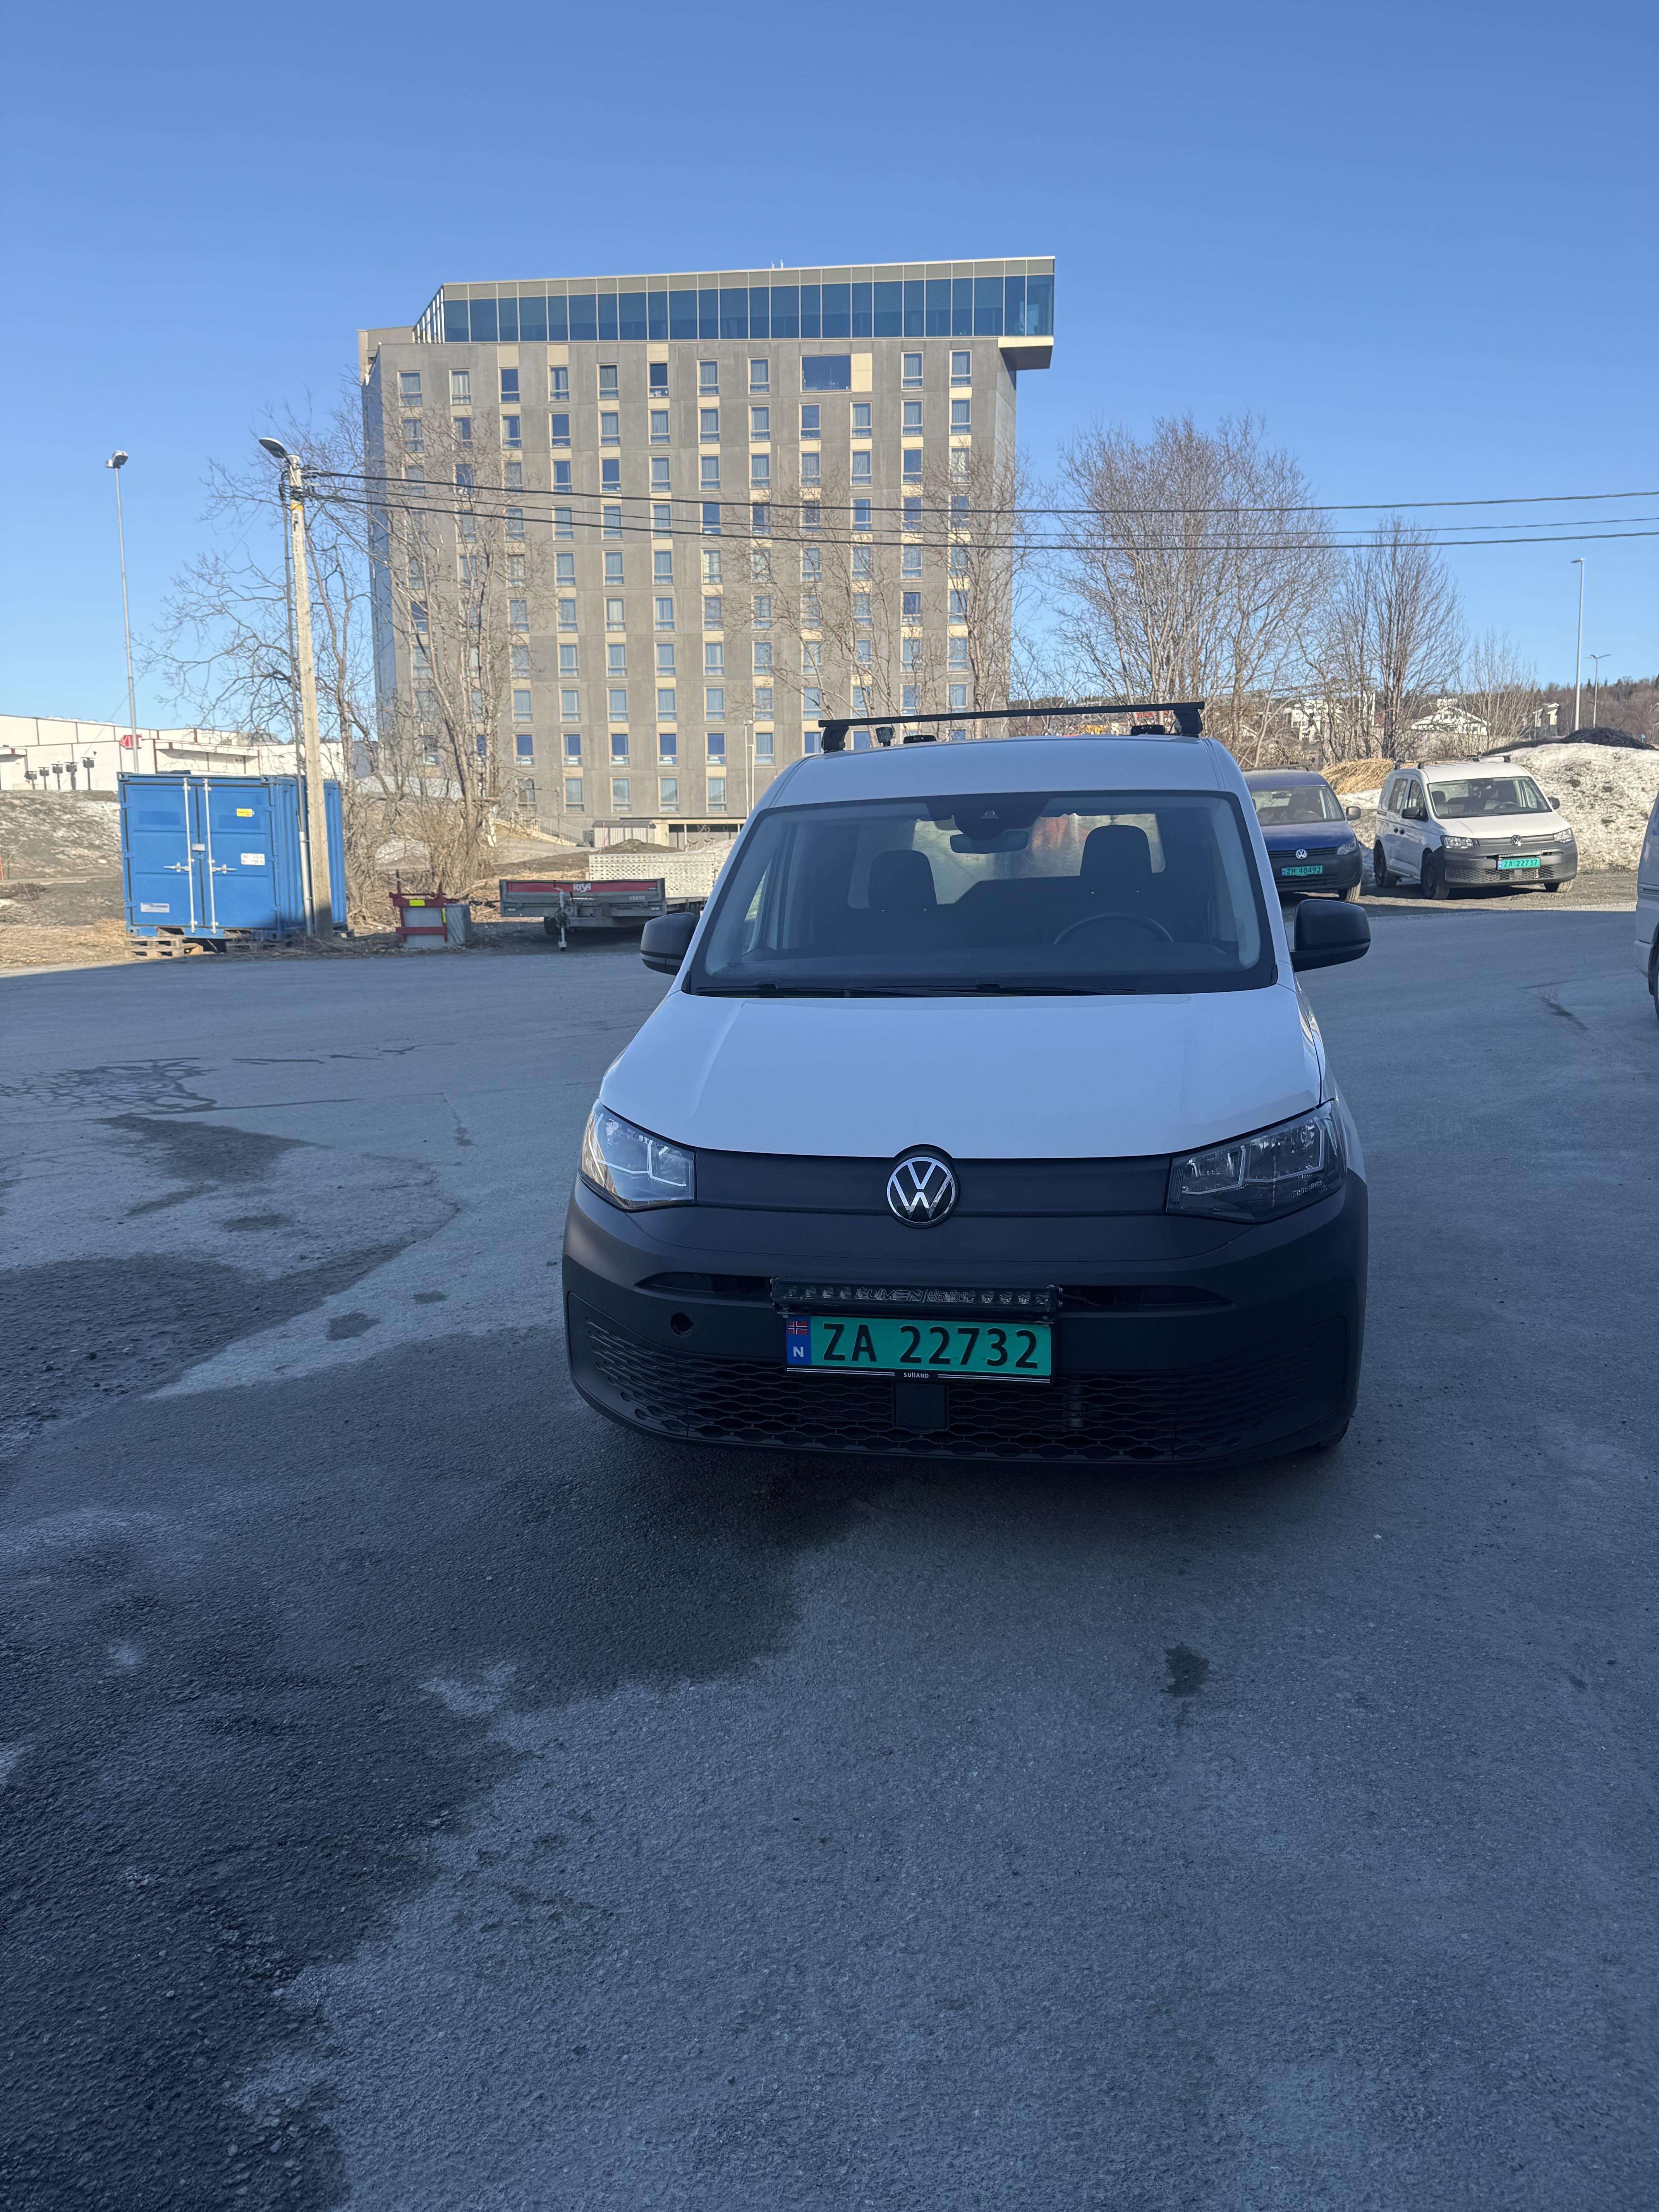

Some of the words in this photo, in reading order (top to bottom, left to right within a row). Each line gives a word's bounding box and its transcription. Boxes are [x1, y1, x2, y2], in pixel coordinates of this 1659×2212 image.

[573, 883, 591, 893] RISA
[823, 1322, 878, 1362] ZA
[899, 1325, 1038, 1369] 22732
[793, 1346, 804, 1357] N
